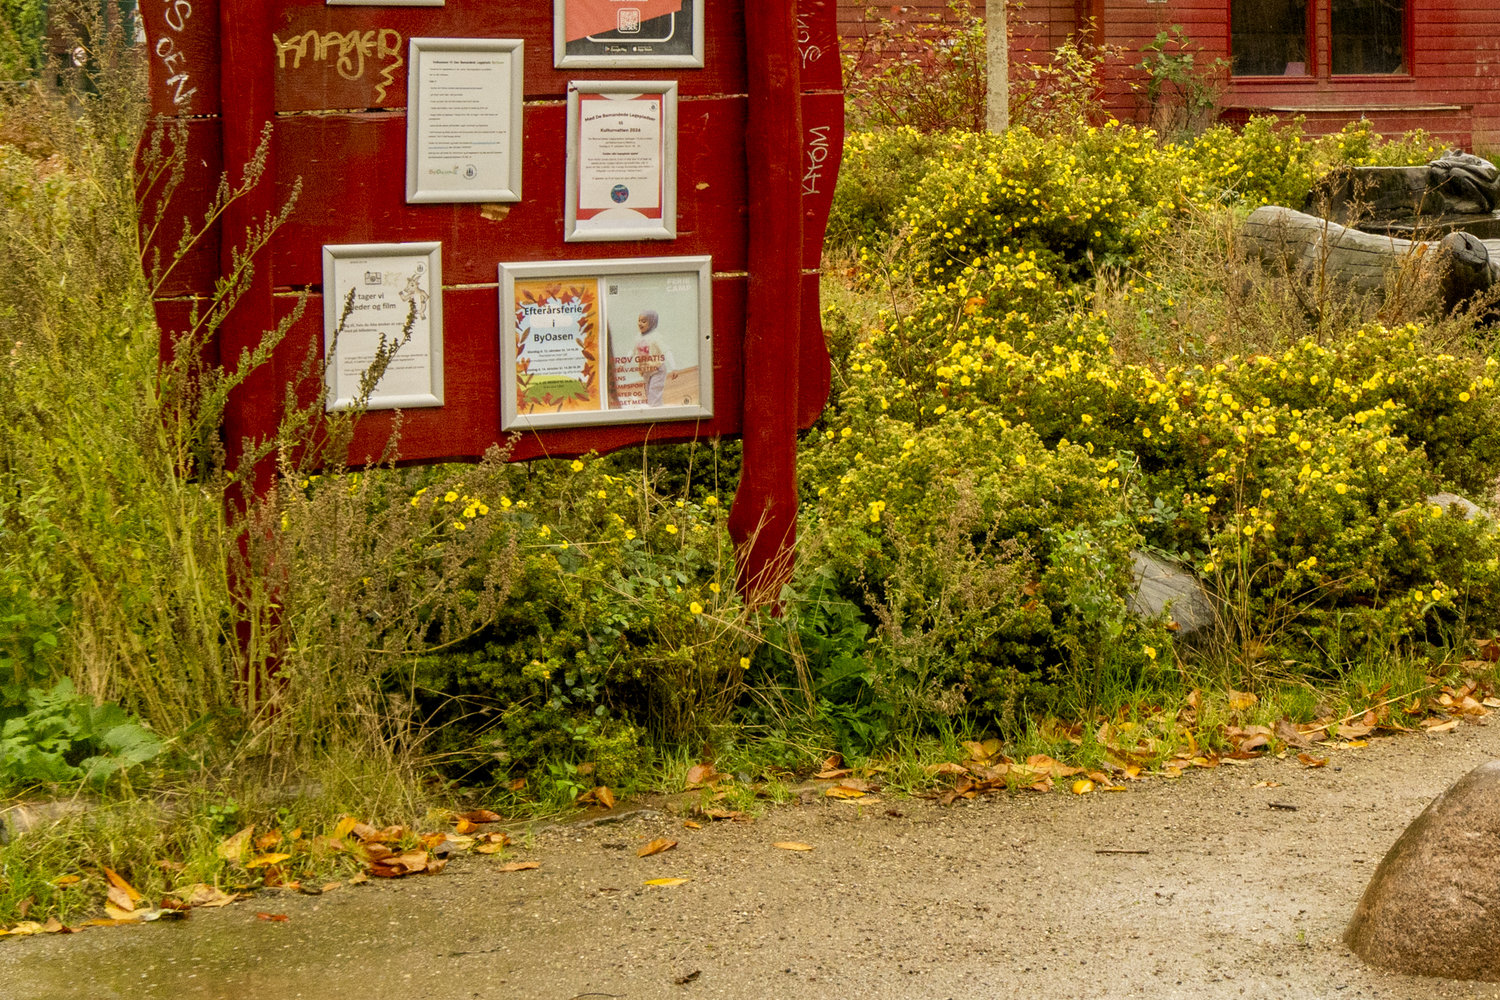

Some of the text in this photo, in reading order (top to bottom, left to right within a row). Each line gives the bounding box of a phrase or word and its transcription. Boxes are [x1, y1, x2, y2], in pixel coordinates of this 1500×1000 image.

[358, 293, 376, 302] tager
[524, 304, 582, 316] Efterårsferie
[552, 319, 555, 327] i
[534, 333, 573, 344] ByOasen
[634, 354, 665, 363] GRATIS
